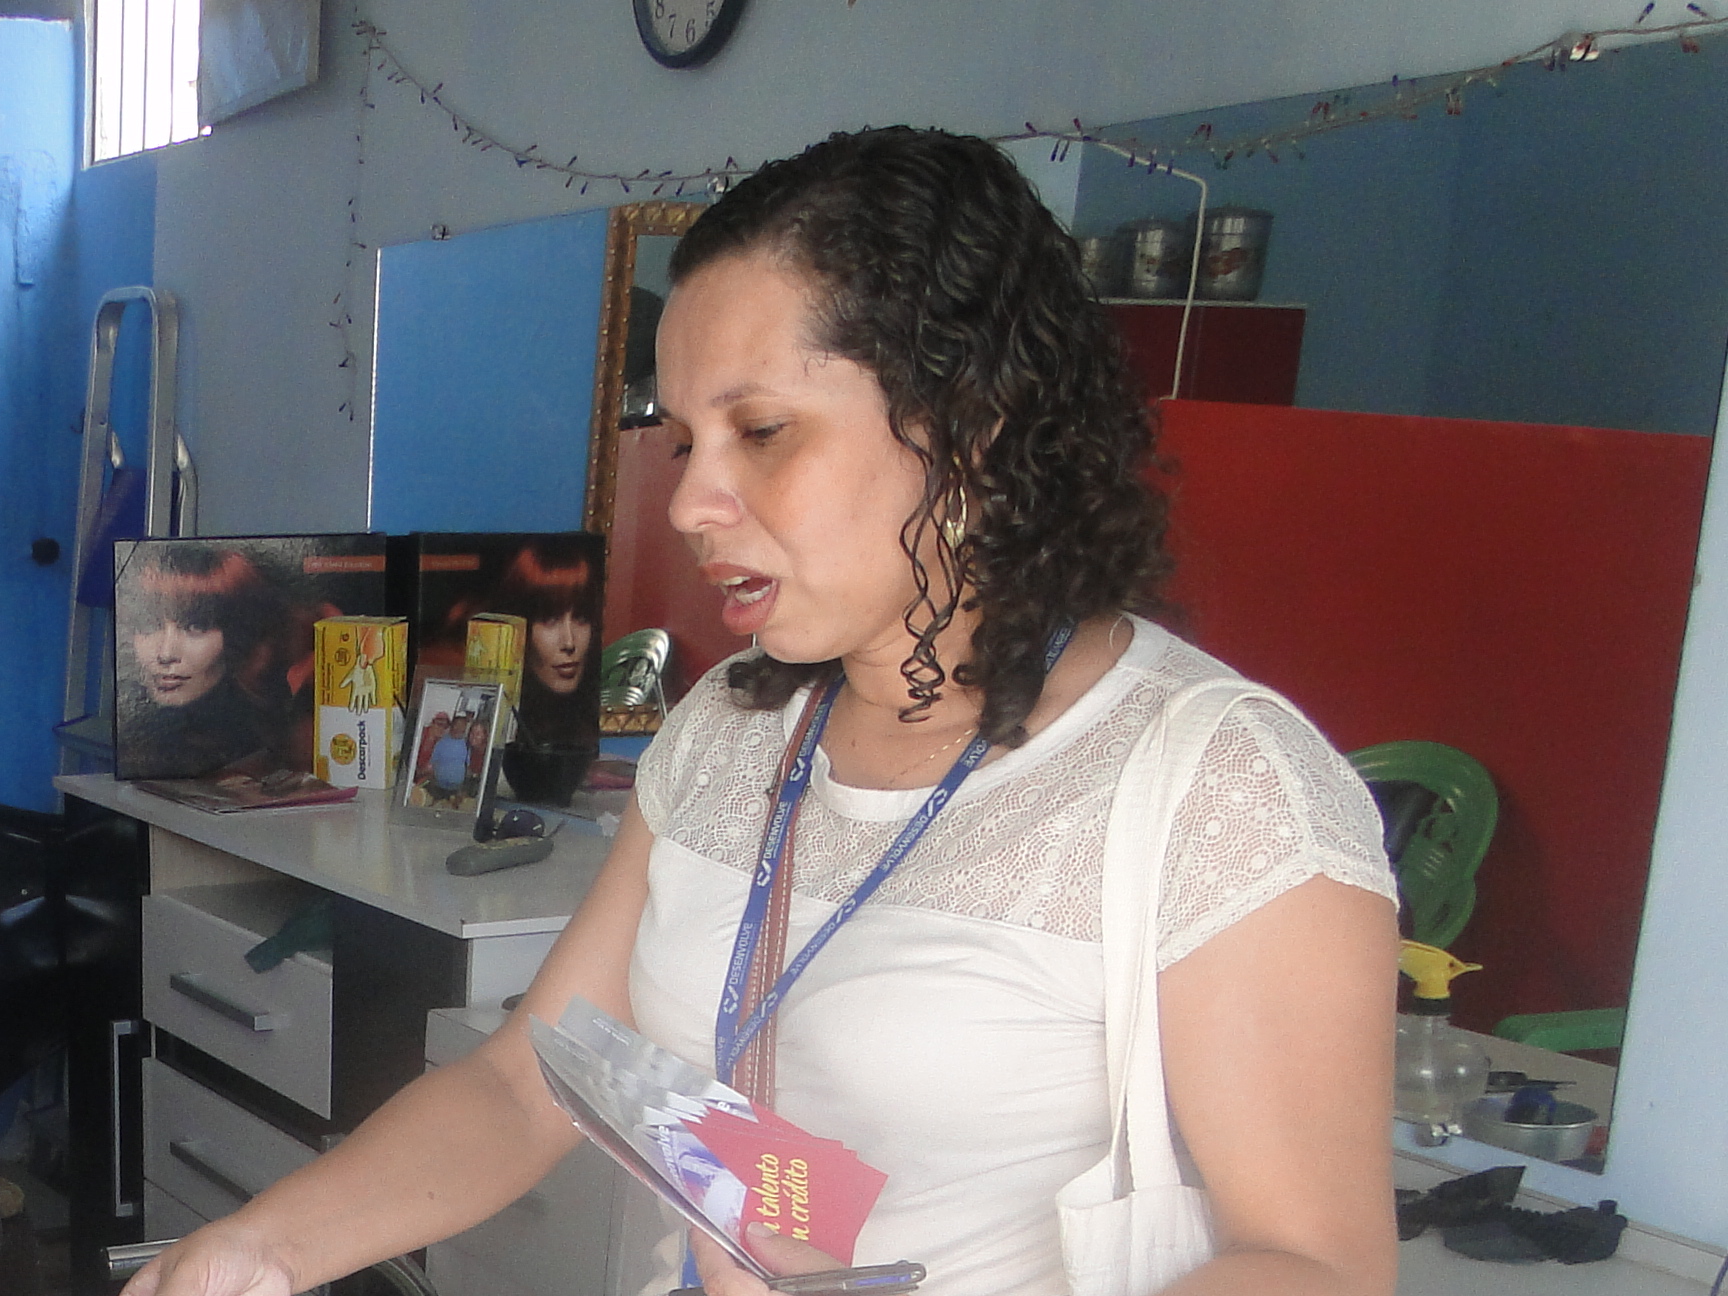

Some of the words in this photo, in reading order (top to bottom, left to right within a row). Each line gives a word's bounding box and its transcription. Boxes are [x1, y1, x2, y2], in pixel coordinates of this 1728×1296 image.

[668, 13, 677, 38] 7
[685, 18, 696, 44] 6
[357, 720, 368, 780] Descarpack
[763, 801, 790, 860] DESENVOLVE
[879, 813, 930, 873] DESENVOLVE
[728, 922, 754, 985] DESENVOLVE
[751, 1153, 781, 1217] talento
[780, 1158, 810, 1222] crédito
